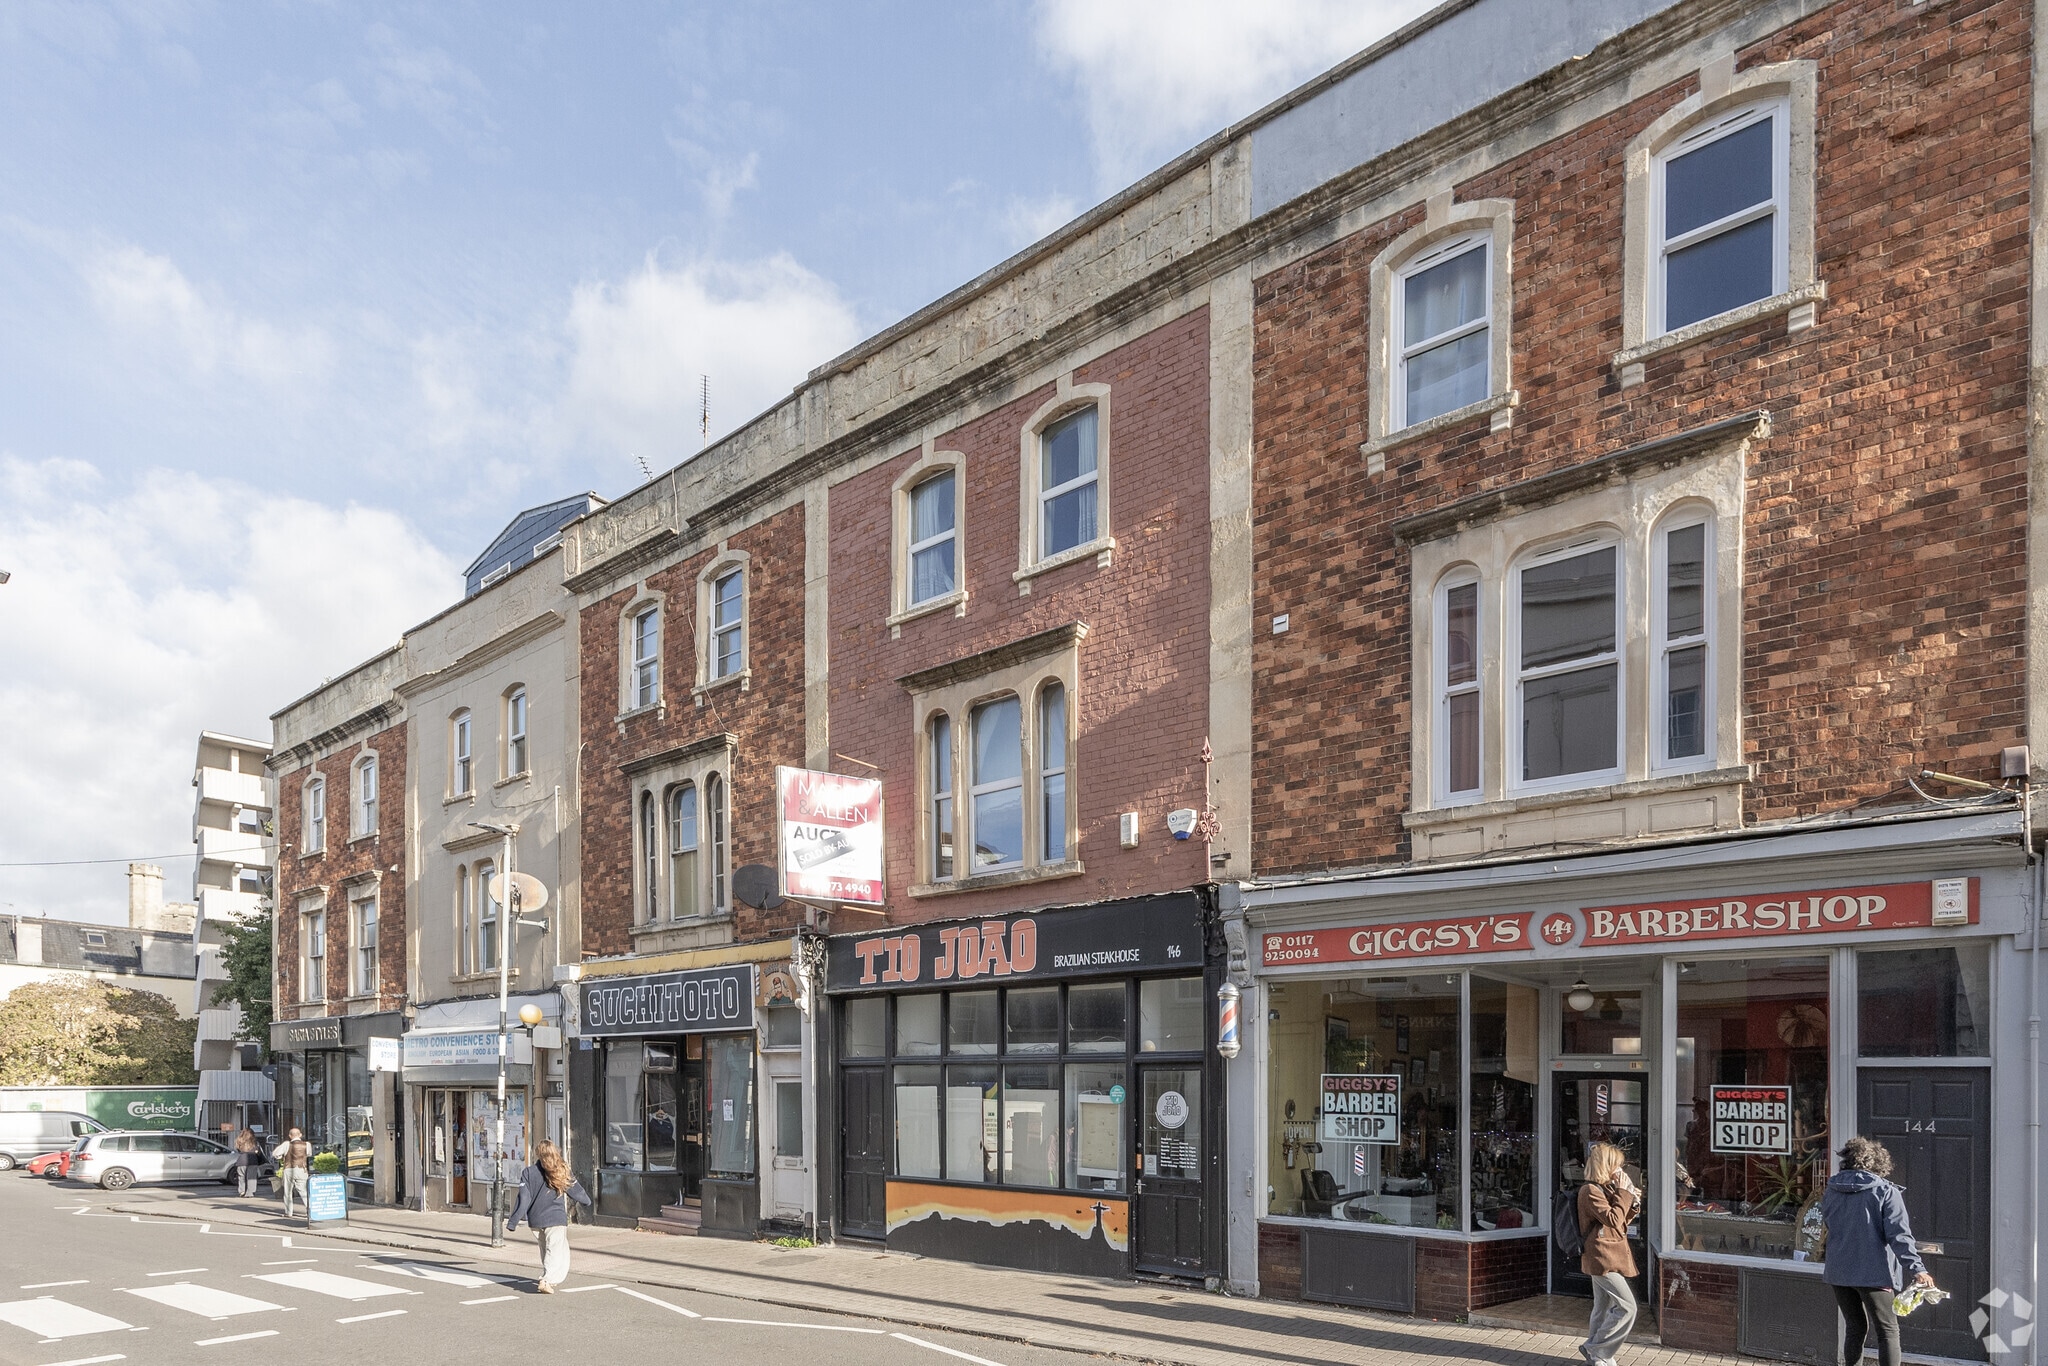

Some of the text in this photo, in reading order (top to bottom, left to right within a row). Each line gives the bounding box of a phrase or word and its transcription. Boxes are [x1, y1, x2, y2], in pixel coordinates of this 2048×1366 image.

[799, 799, 868, 823] & ALLEN
[799, 848, 823, 865] SOLD
[845, 882, 872, 895] 4940
[1590, 894, 1887, 939] BARBERSHOP
[1349, 916, 1521, 956] GIGGSY'S
[1543, 919, 1572, 936] 144
[1286, 935, 1314, 946] 0117
[855, 919, 1037, 985] TIO JOÃO
[1054, 949, 1140, 967] BRAZILIAN STEAKHOUSE
[1166, 945, 1181, 958] 146
[1265, 948, 1319, 961] 9250094
[588, 977, 740, 1026] SUCHITOTO
[310, 1025, 338, 1040] STYLES
[405, 1033, 512, 1049] METRO CONVENIENCE STOE
[429, 1049, 453, 1057] EUROPEAN
[456, 1048, 470, 1056] ASIAN
[472, 1048, 486, 1056] FOOD
[1324, 1077, 1397, 1091] GIGGSY'S
[1324, 1092, 1397, 1113] BARBER
[1715, 1090, 1786, 1099] GIGGSY'S
[127, 1101, 191, 1120] Carlsberg
[1715, 1101, 1786, 1120] BARBER
[1334, 1116, 1386, 1138] SHOP
[1722, 1124, 1780, 1146] SHOP
[1904, 1120, 1936, 1133] 144
